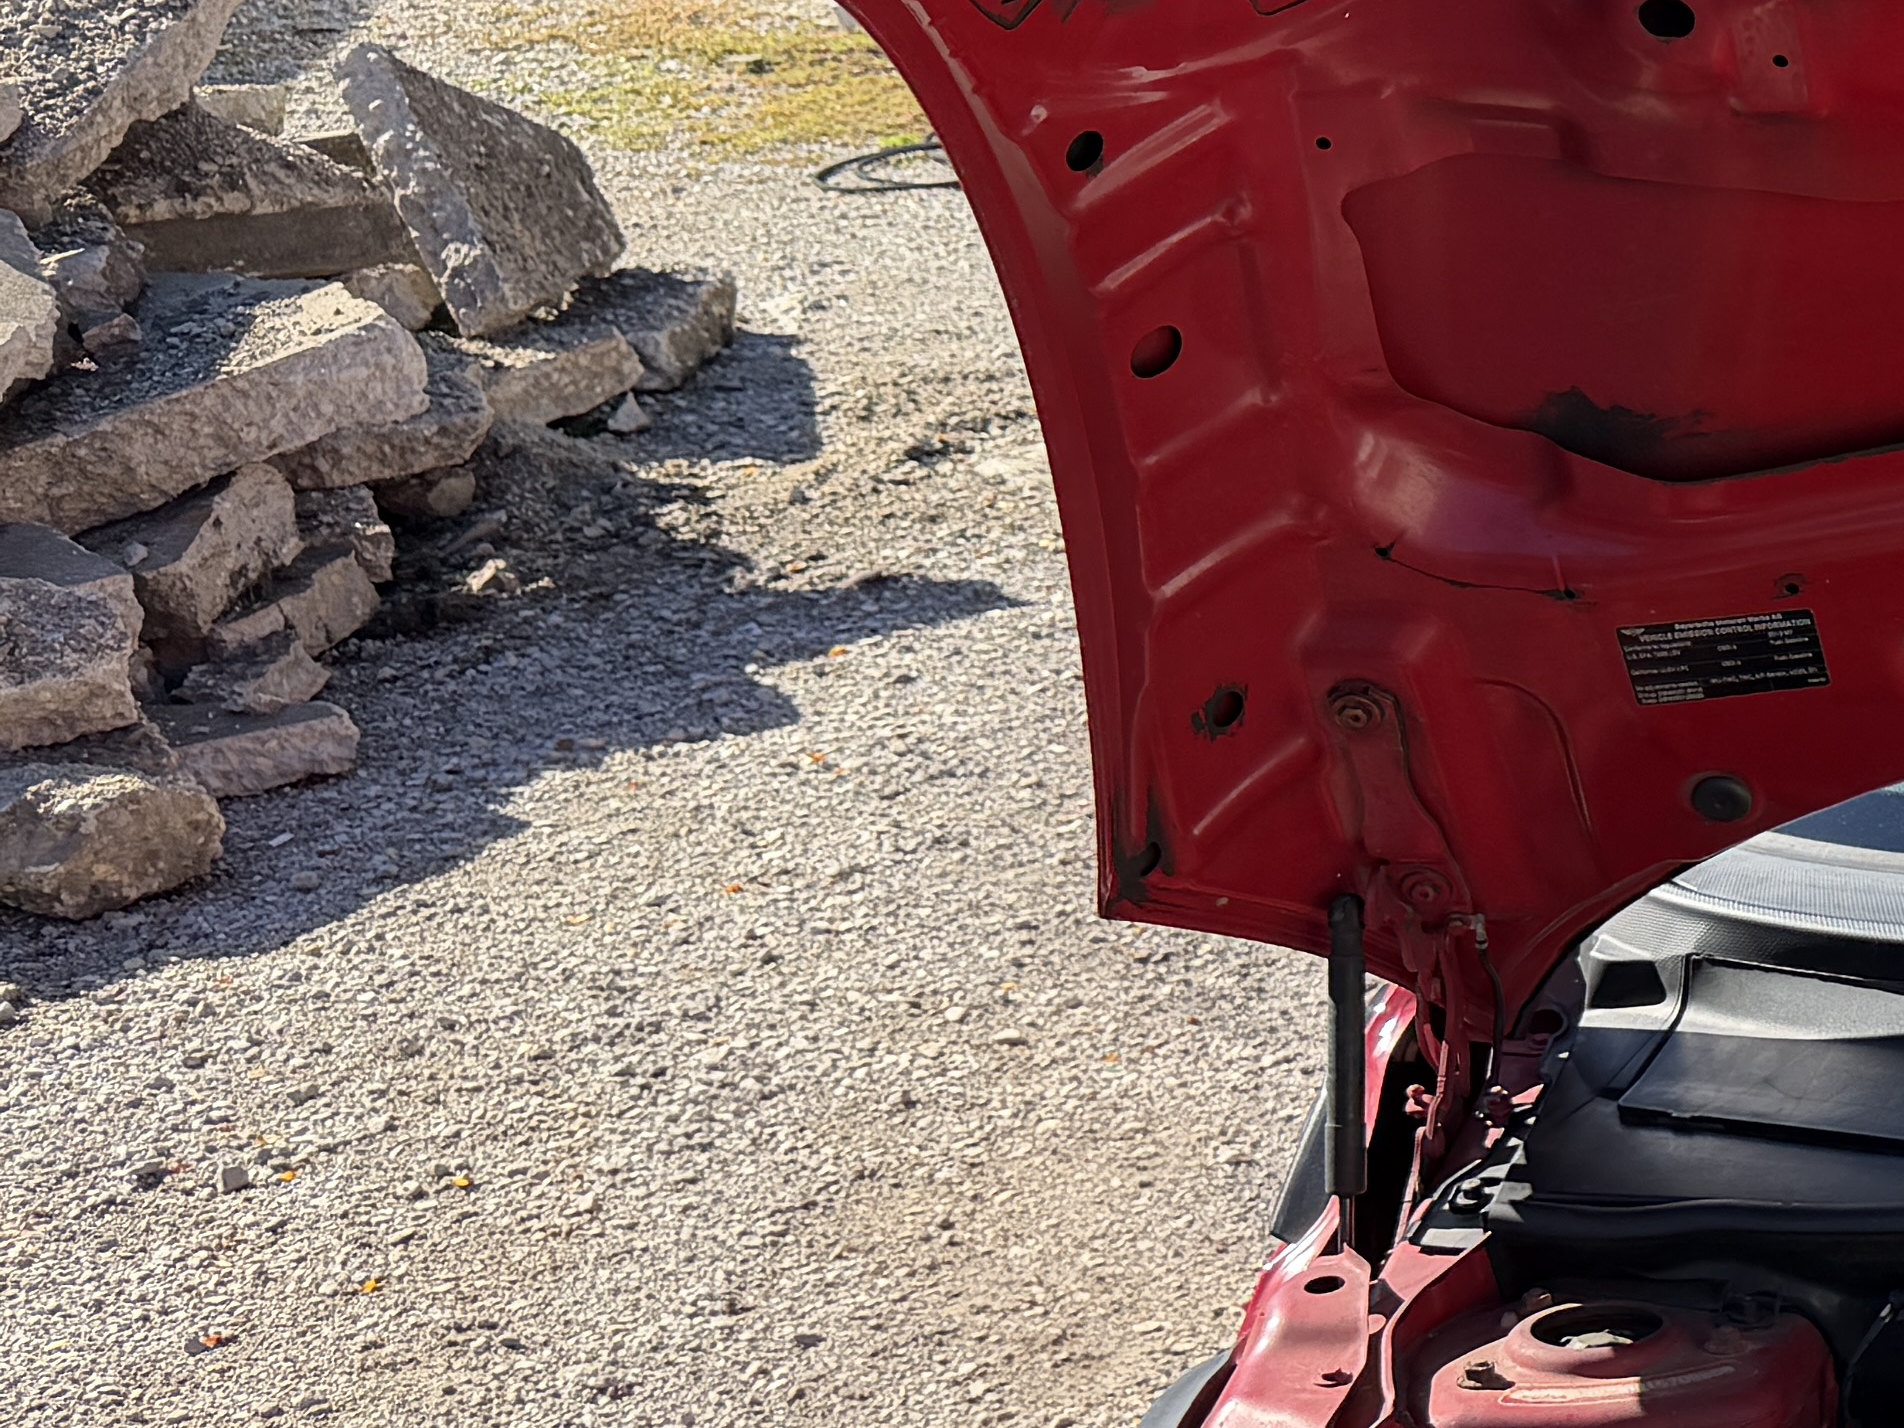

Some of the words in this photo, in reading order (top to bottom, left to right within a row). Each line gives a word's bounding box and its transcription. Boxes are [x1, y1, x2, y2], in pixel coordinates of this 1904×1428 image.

[1639, 632, 1672, 642] VEHICLE
[1715, 625, 1753, 635] CONTROL
[1754, 619, 1811, 630] INFORMATION
